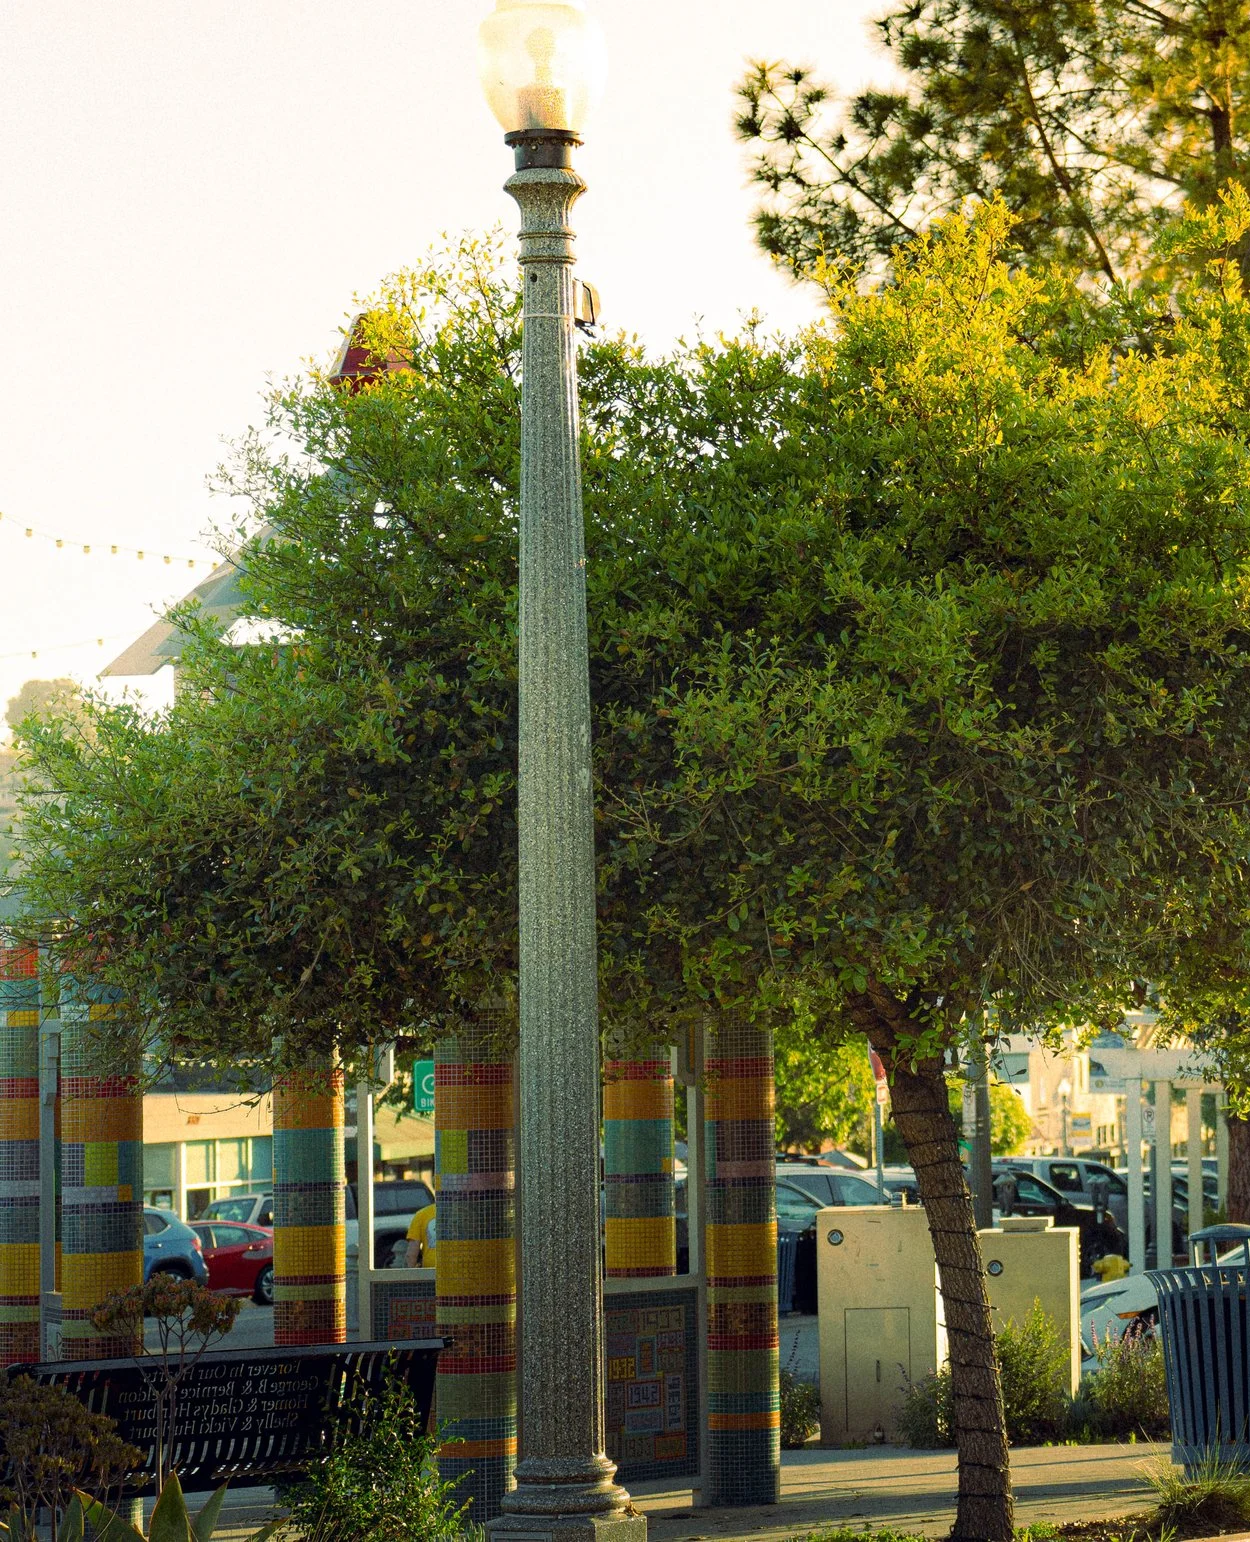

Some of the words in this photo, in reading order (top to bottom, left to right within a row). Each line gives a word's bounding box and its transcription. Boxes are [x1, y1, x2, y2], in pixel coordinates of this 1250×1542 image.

[421, 1098, 434, 1107] BIK
[609, 1357, 635, 1379] 1932
[630, 1385, 658, 1404] 1942
